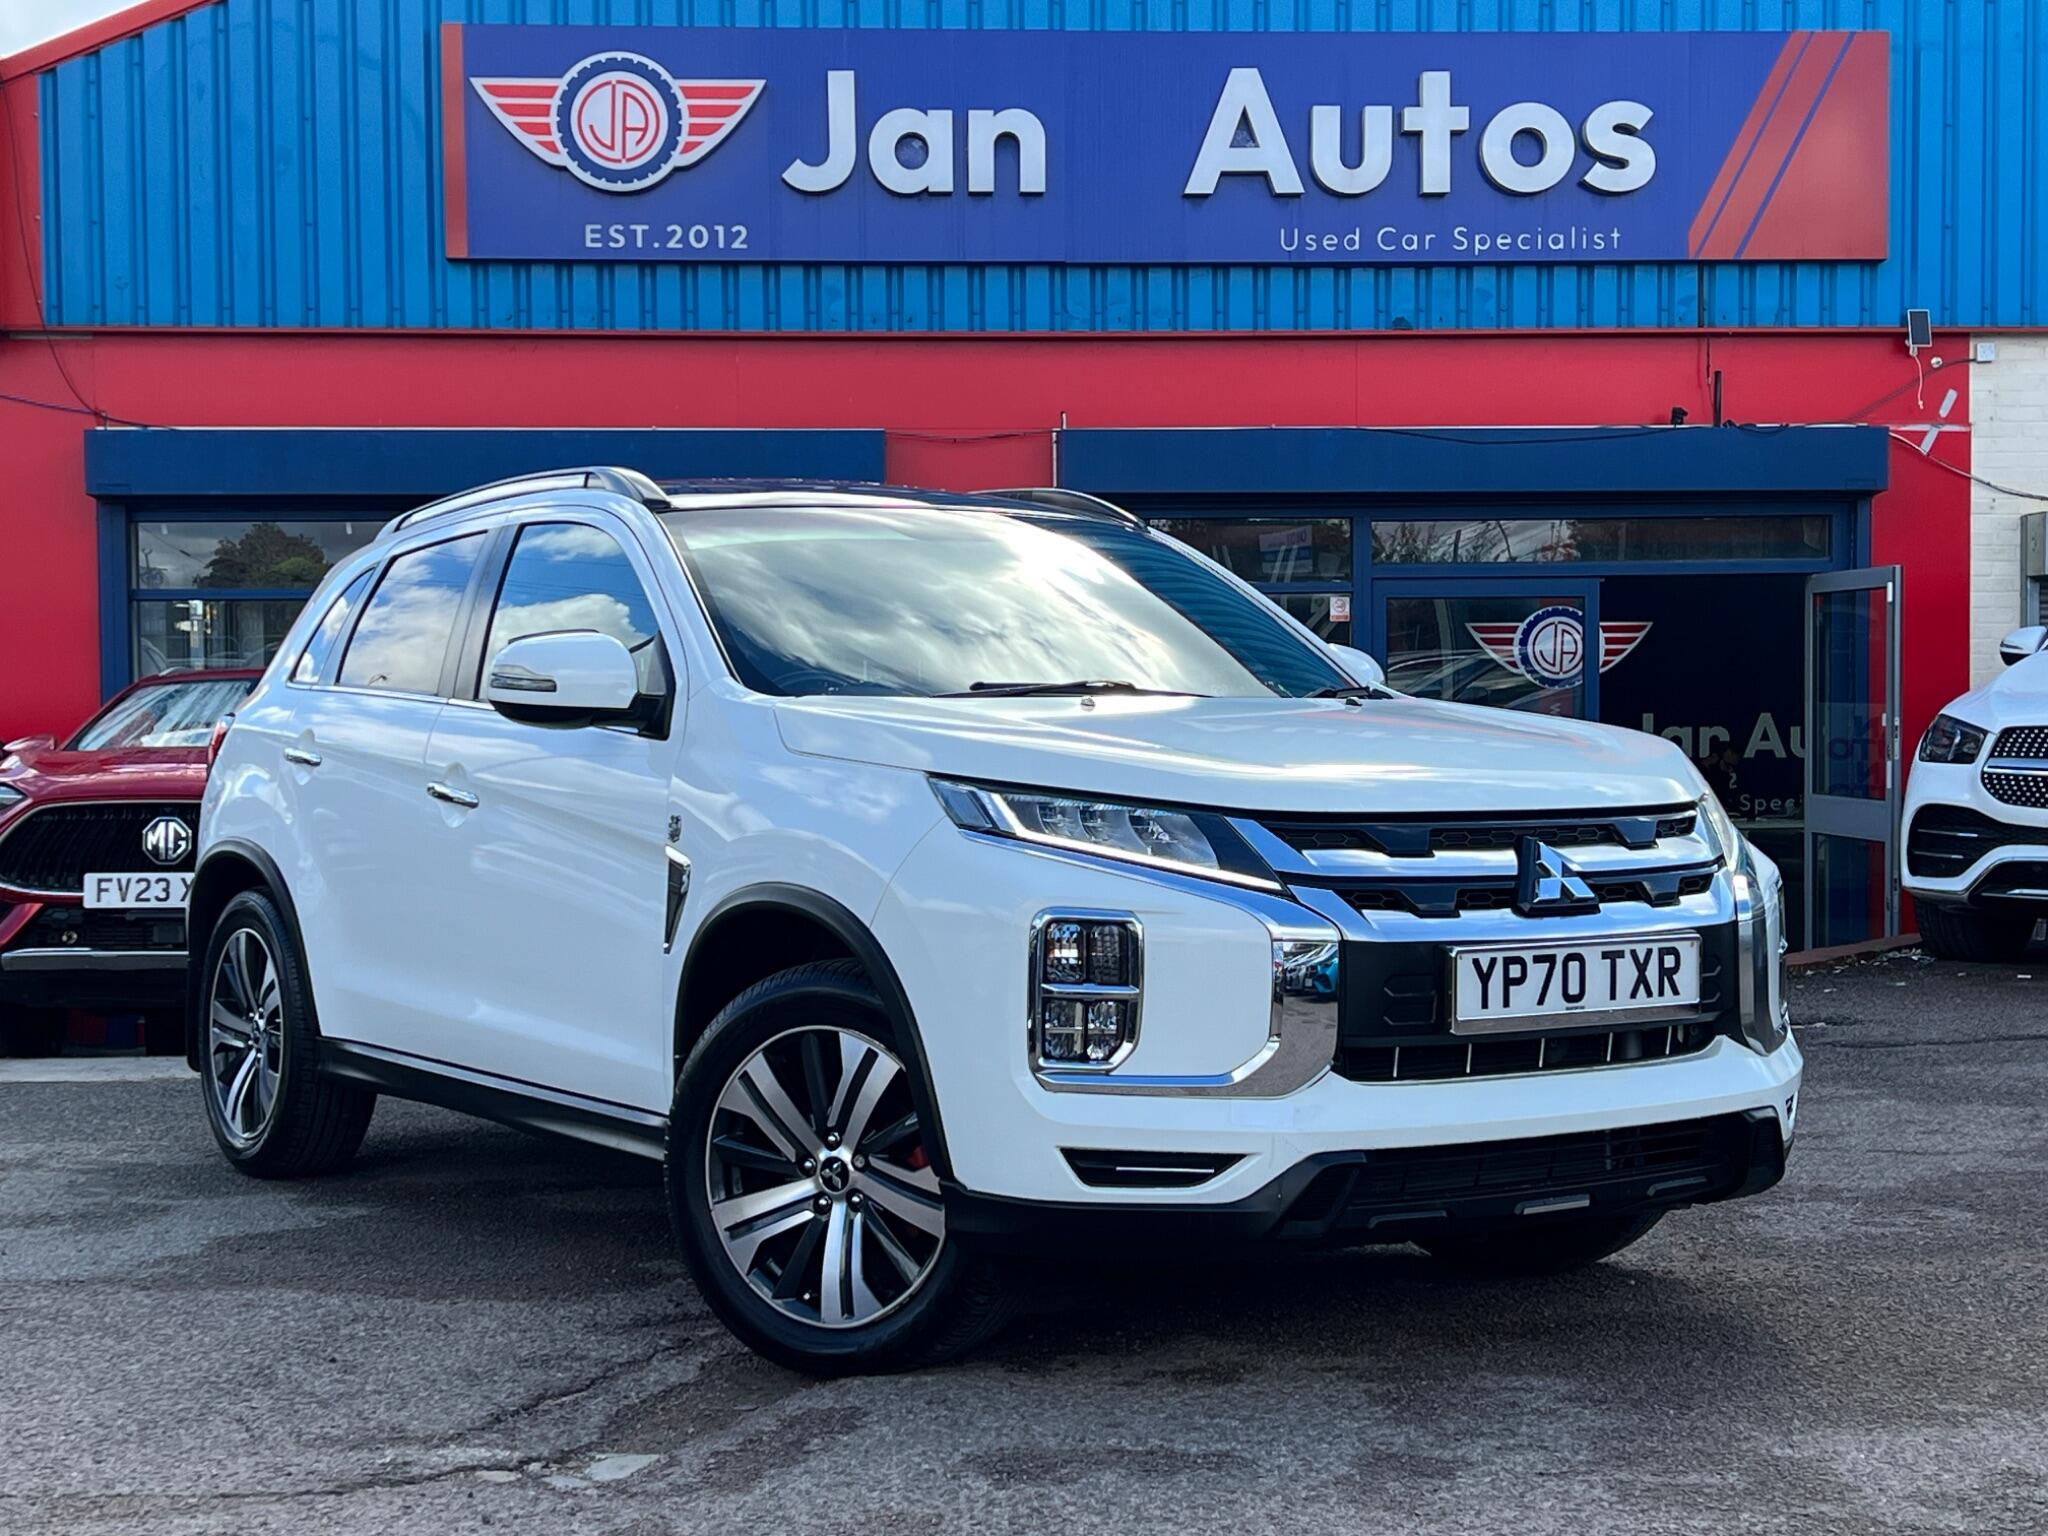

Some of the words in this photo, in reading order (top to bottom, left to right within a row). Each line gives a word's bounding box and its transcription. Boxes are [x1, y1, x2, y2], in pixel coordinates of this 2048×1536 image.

[781, 69, 1046, 195] Jan
[1182, 67, 1657, 198] Autos
[584, 224, 749, 250] EST.2012
[1279, 227, 1361, 252] Used
[1376, 227, 1436, 251] Car
[1452, 226, 1622, 256] Specialist
[146, 821, 187, 860] MG
[96, 877, 171, 903] FV23
[1471, 952, 1586, 1010] YP70
[1601, 946, 1681, 1001] TXR
